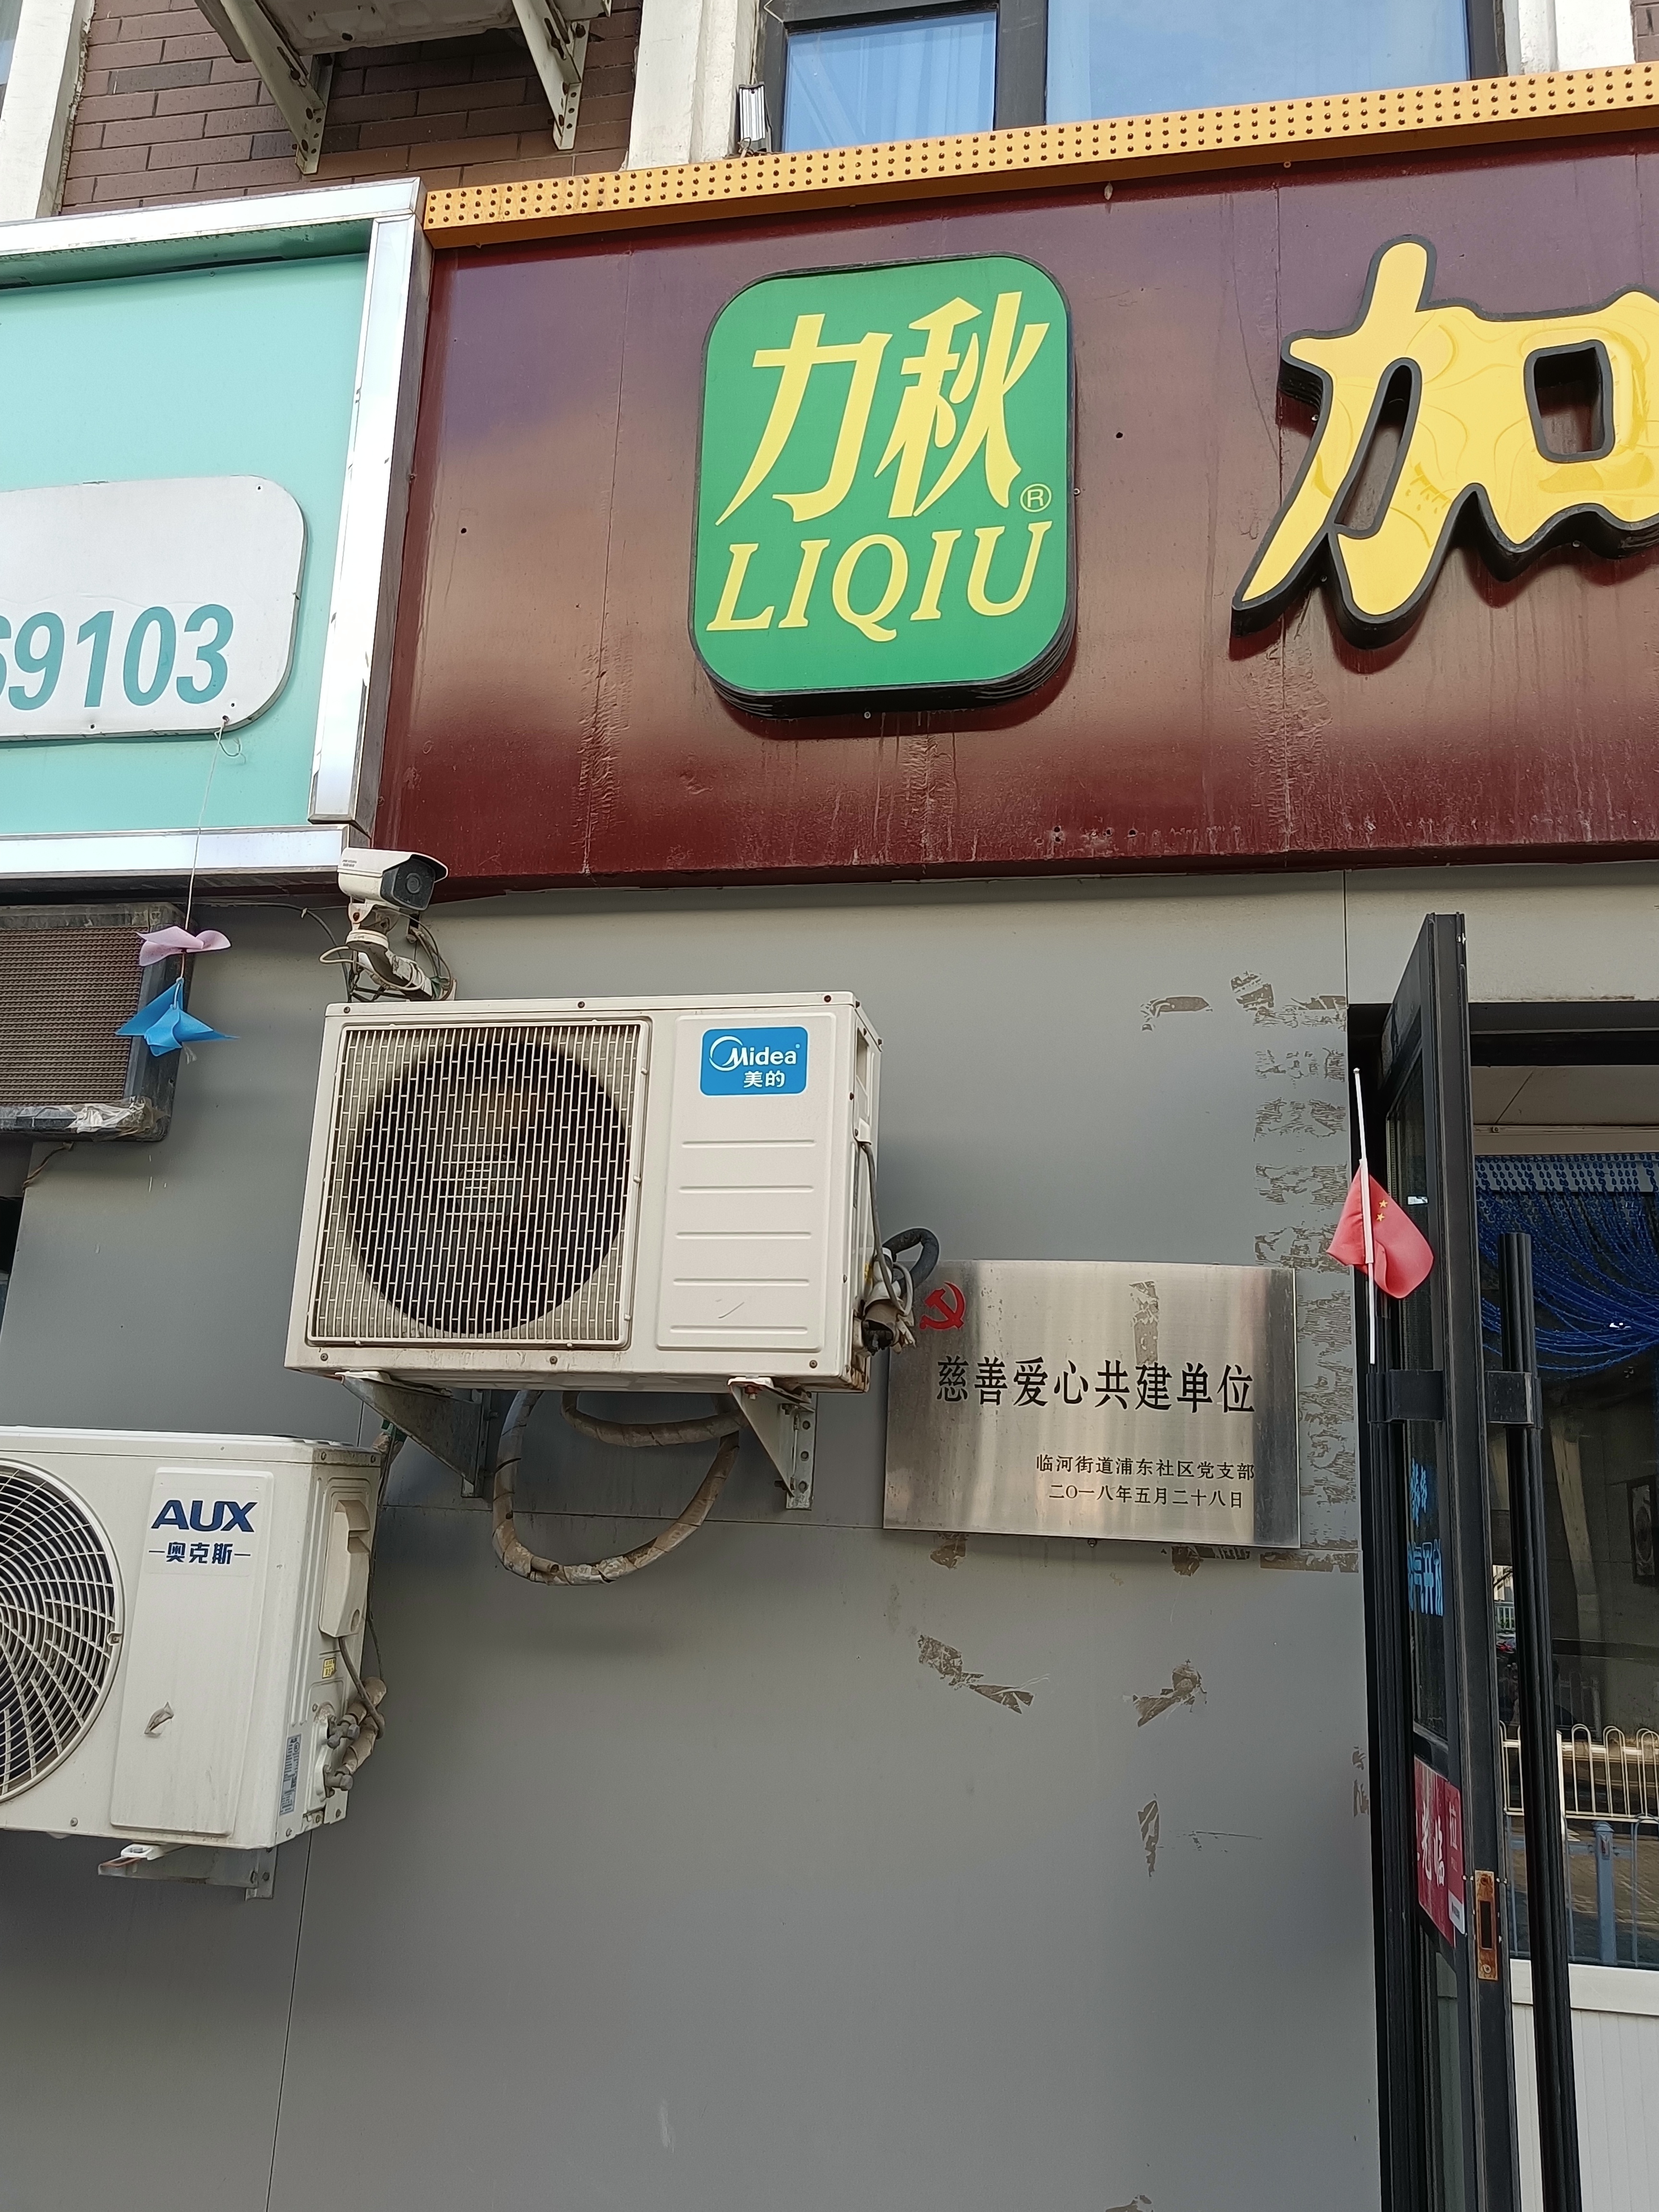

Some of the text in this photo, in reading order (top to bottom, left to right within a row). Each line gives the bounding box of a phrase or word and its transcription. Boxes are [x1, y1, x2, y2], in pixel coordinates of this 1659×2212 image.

[715, 291, 1050, 527] 力秋
[1232, 234, 1659, 623] 加
[706, 520, 1053, 642] LIQIU
[0, 604, 233, 710] 9103
[720, 1046, 797, 1067] Midea
[743, 1070, 785, 1088] 美的
[937, 1355, 1255, 1413] 慈善爱心共建单位
[1036, 1454, 1255, 1481] 临河街道浦东社区党支部
[151, 1500, 258, 1532] AUX
[166, 1542, 233, 1564] 奥克斯
